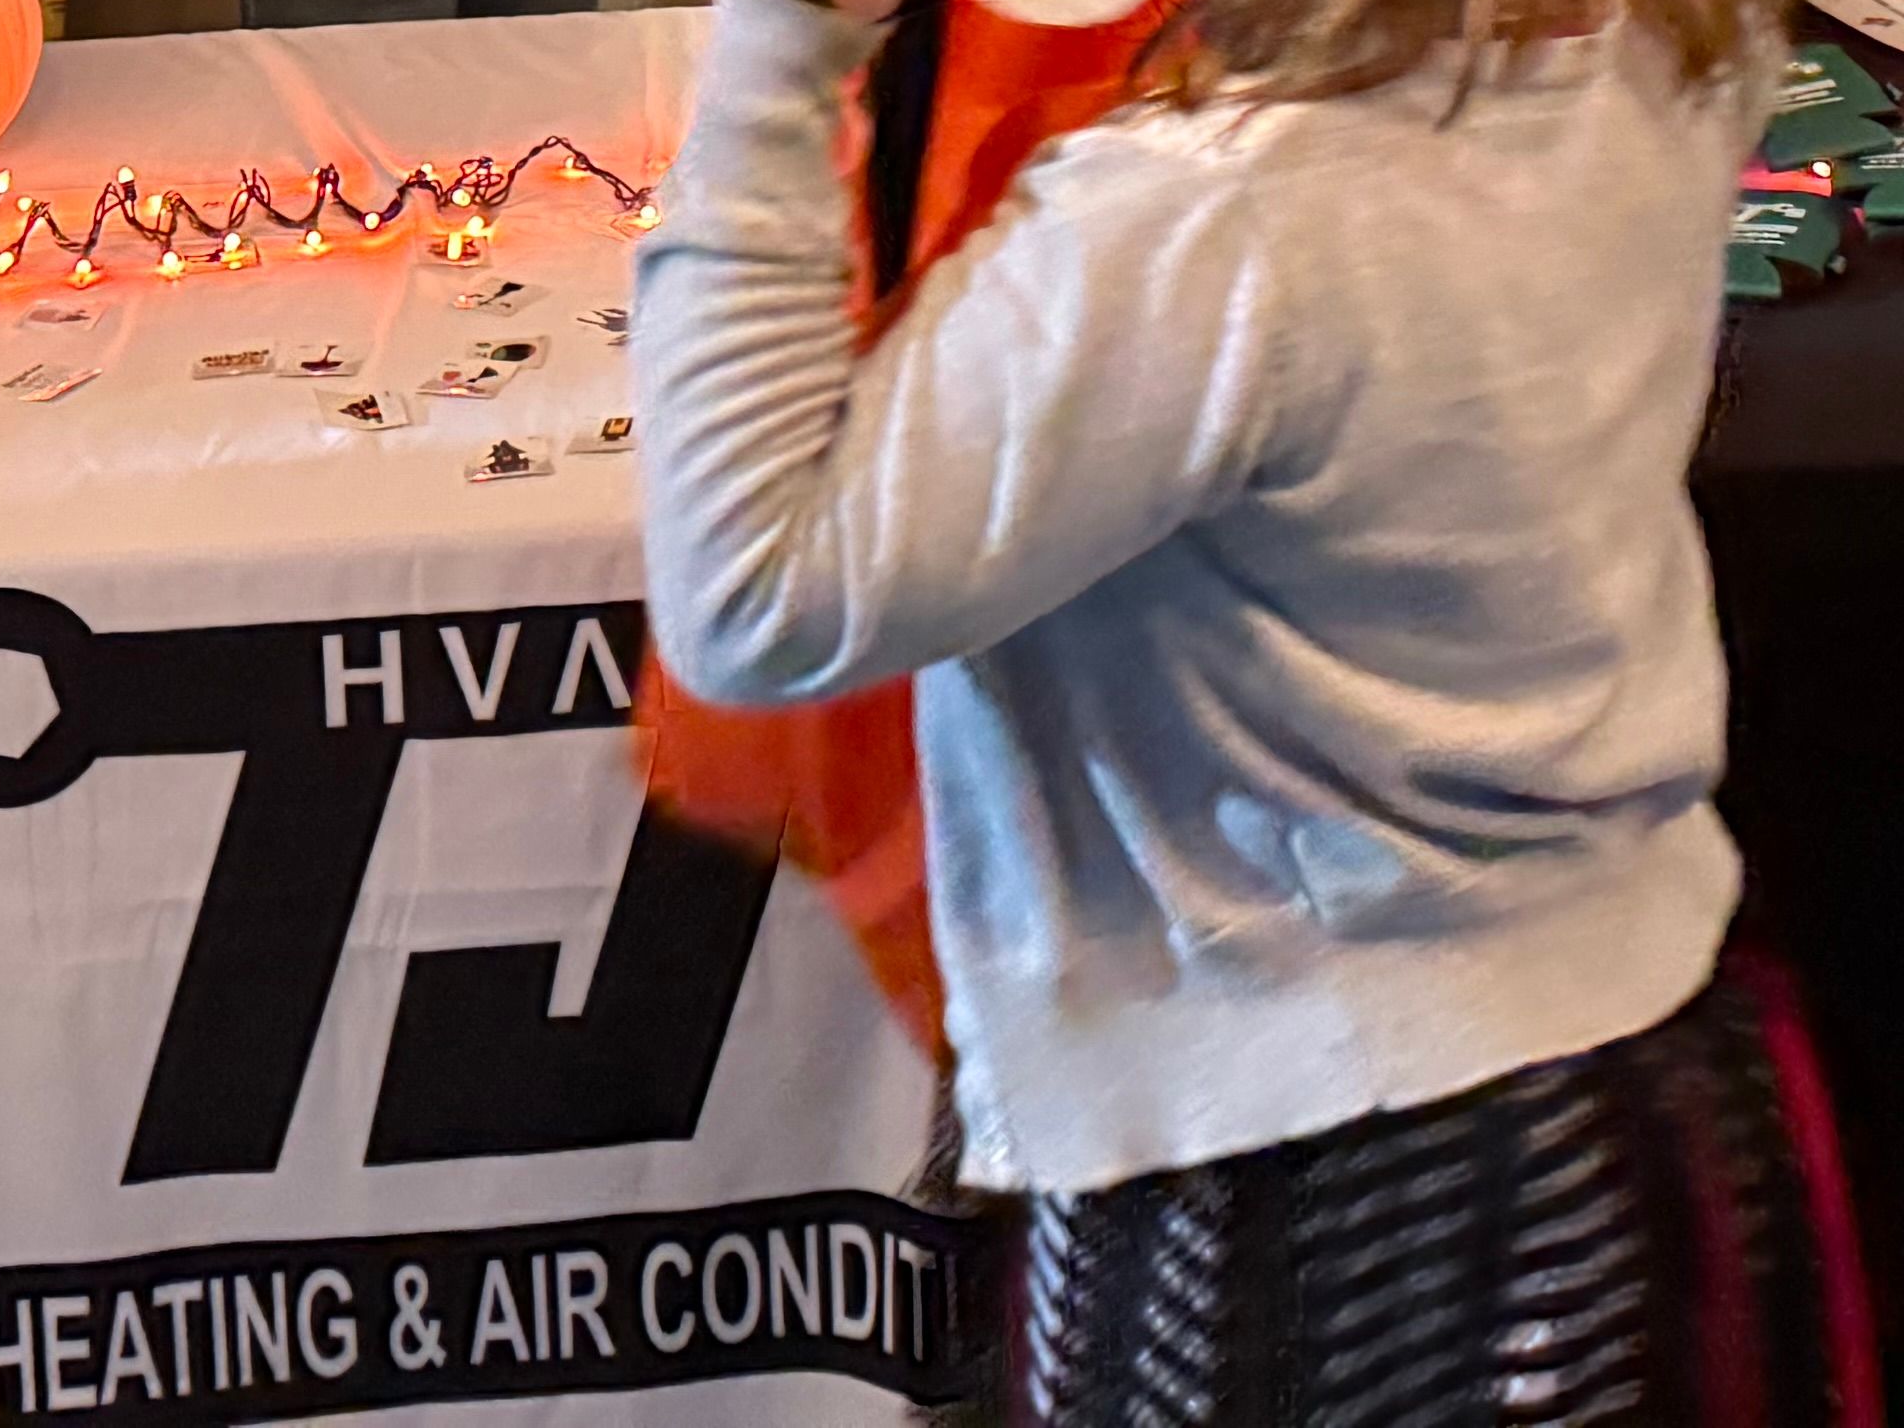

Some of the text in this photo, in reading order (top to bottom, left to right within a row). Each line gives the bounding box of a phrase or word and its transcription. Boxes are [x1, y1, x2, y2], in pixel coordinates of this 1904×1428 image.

[322, 617, 632, 729] HVA
[389, 1263, 447, 1371] &
[469, 1249, 617, 1366] AIR
[641, 1223, 937, 1362] CONDIT
